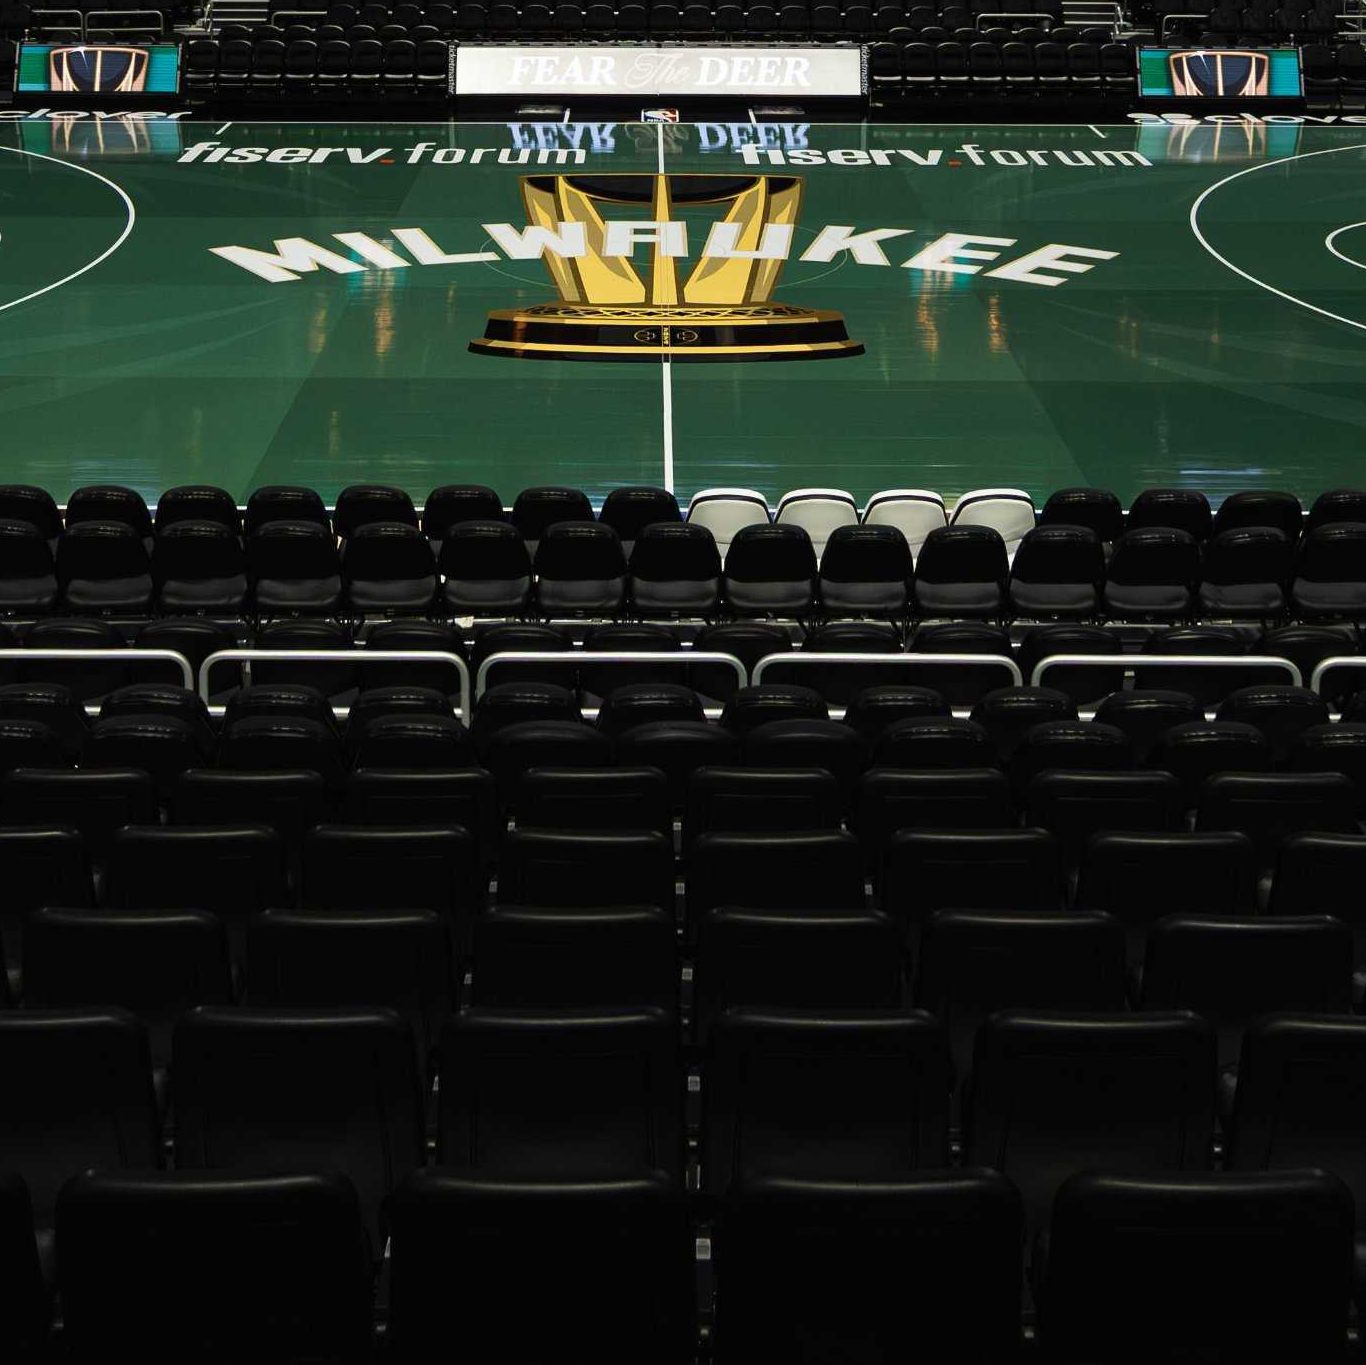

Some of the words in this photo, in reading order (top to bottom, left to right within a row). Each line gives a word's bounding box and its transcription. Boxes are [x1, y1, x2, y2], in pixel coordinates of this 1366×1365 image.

[507, 56, 616, 87] FEAR
[697, 57, 812, 88] DEER
[403, 142, 586, 164] forum
[955, 144, 1153, 167] forum
[208, 220, 1122, 287] MILWAUKEE
